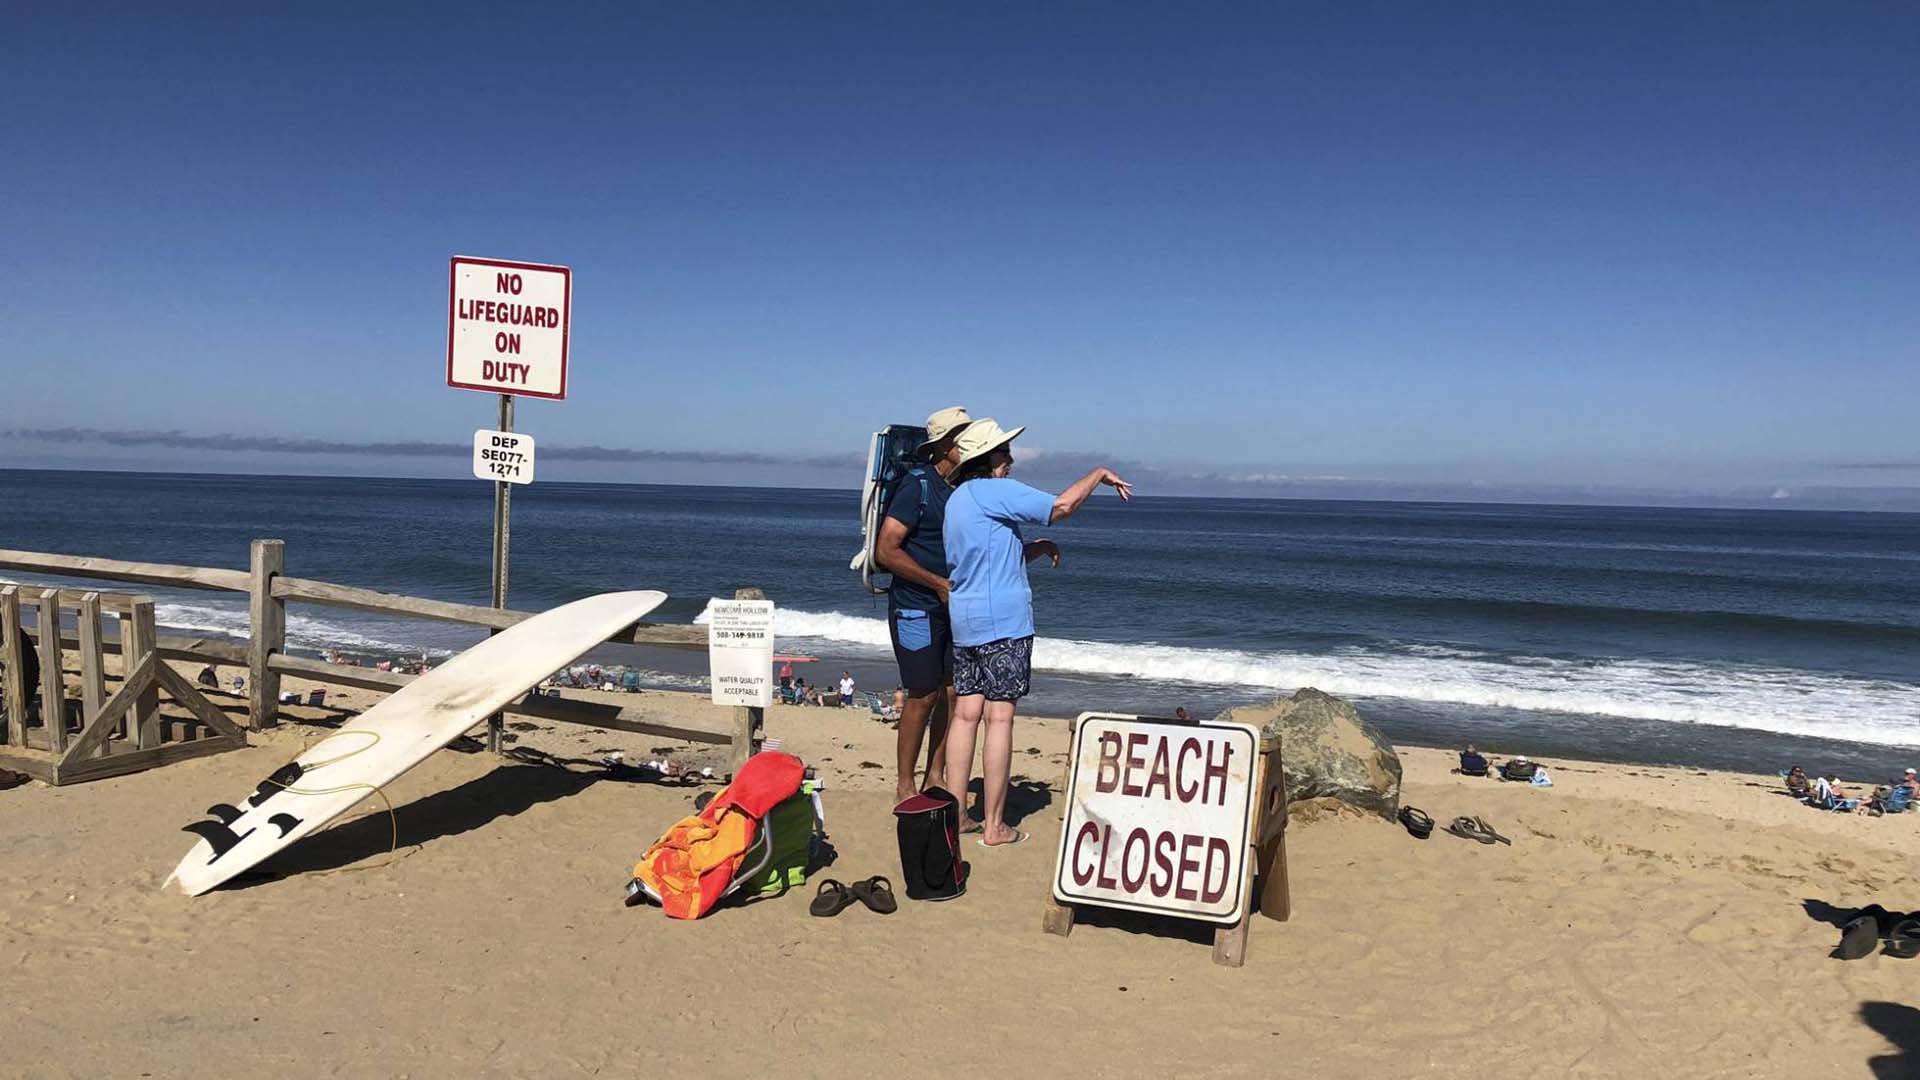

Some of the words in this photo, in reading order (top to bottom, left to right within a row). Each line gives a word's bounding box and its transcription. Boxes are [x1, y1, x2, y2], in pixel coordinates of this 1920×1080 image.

[497, 273, 522, 295] NO
[459, 299, 559, 329] LIFEGUARD
[495, 332, 521, 354] ON
[482, 360, 531, 384] DUTY
[491, 436, 518, 449] DEP
[481, 449, 528, 465] SE077-
[489, 463, 520, 476] 1271
[743, 607, 768, 615] HOLLOW
[724, 688, 759, 696] ACCEPTABLE
[1095, 730, 1231, 807] BEACH
[1072, 821, 1231, 905] CLOSED
